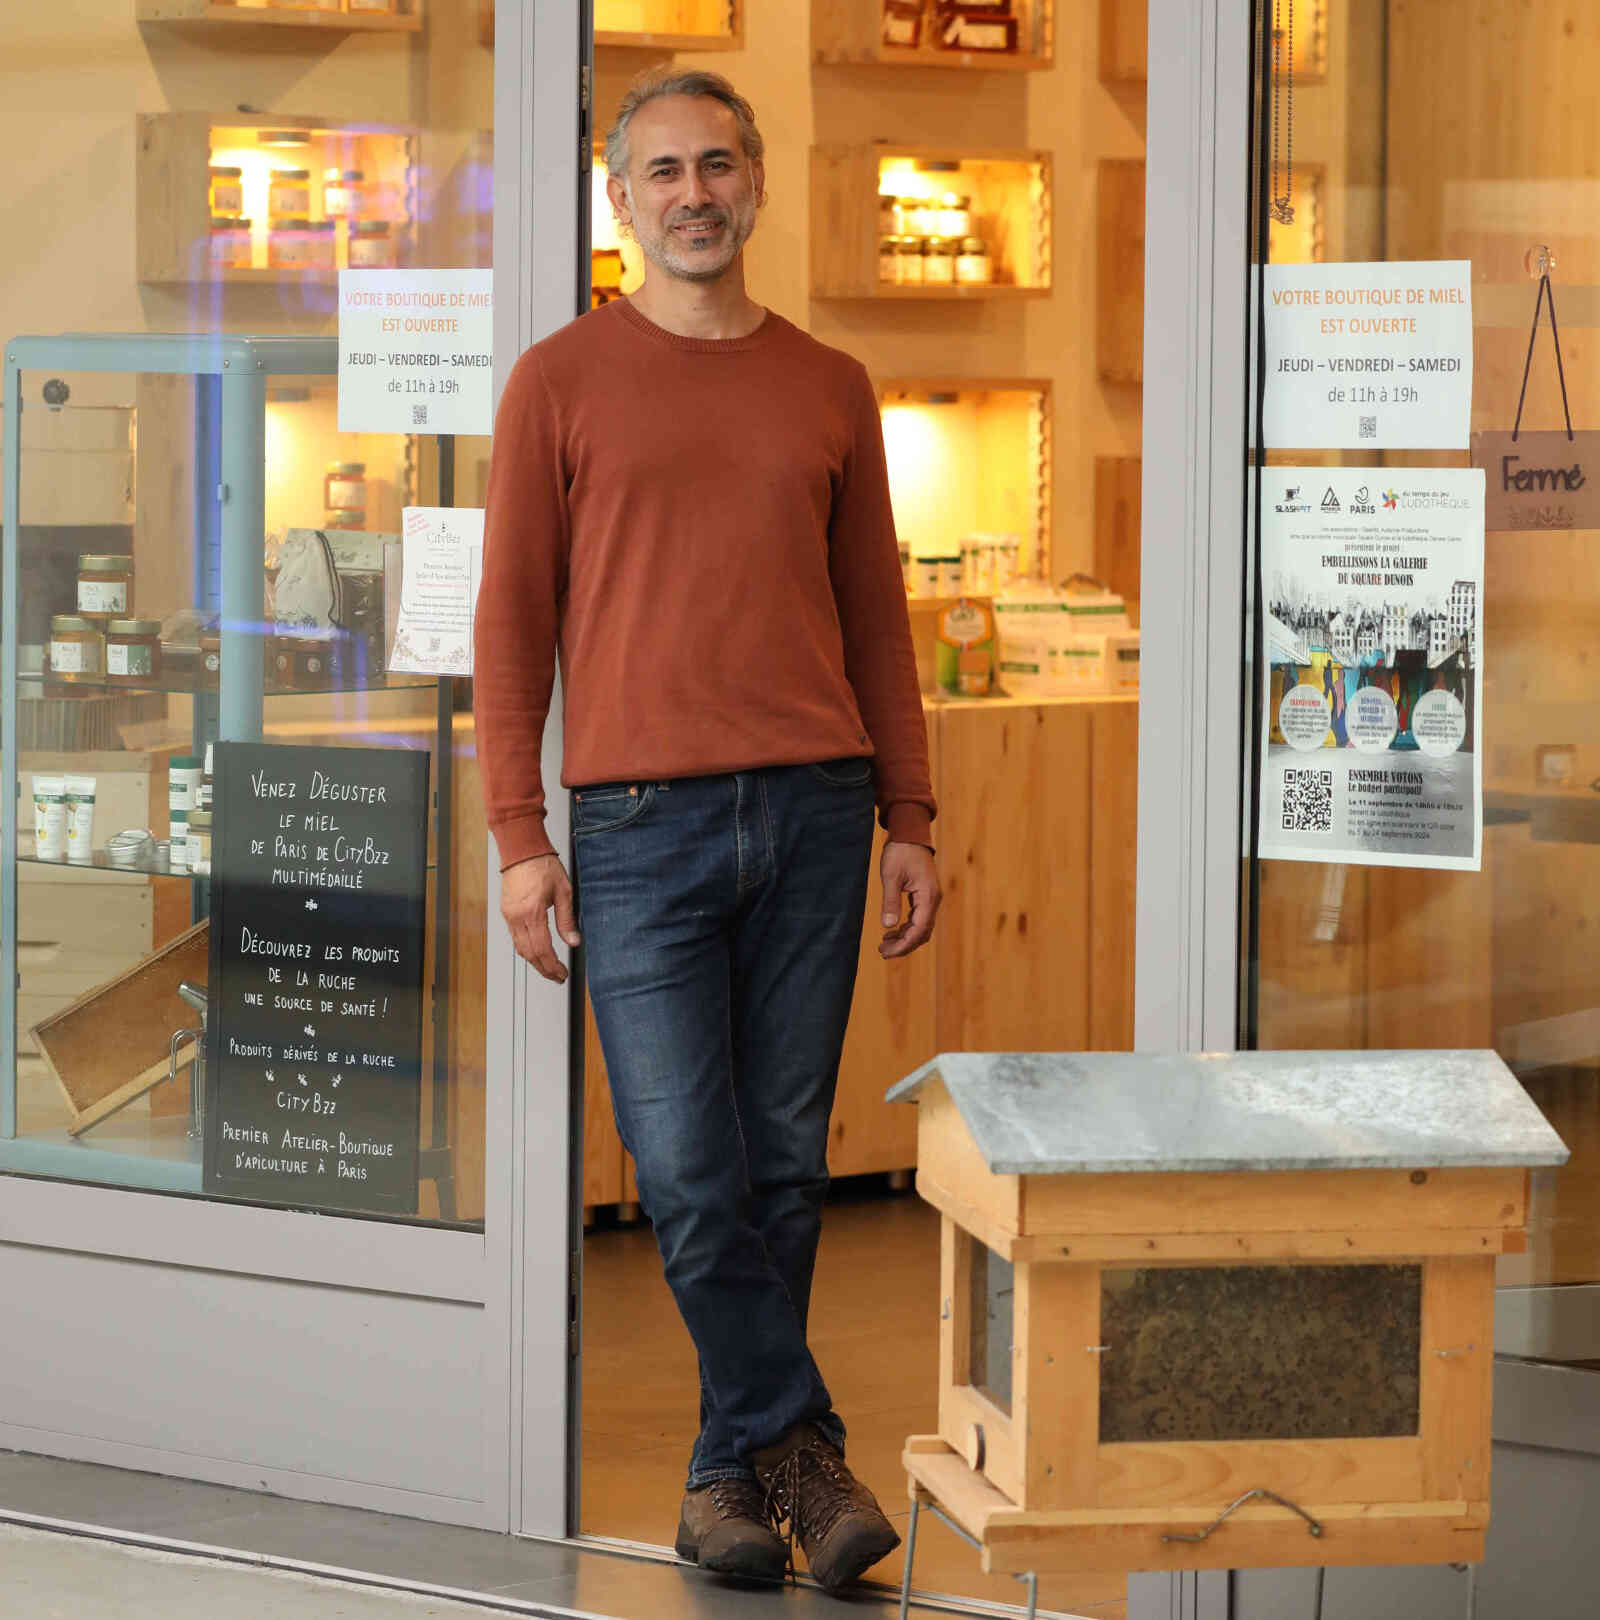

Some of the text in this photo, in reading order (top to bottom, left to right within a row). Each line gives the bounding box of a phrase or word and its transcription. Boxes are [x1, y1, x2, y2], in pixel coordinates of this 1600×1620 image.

[345, 292, 383, 307] VOTRE
[386, 292, 448, 309] BOUTIQUE
[450, 293, 465, 307] DE
[1272, 288, 1465, 306] VOTRE BOUTIQUE DE MIEL
[382, 318, 458, 332] EST OUVERTE
[1320, 318, 1417, 334] EST OUVERTE
[348, 353, 377, 366] JEUDI
[387, 353, 440, 366] VENDREDI
[451, 354, 493, 367] SAMEDI
[1277, 359, 1314, 373] JEUDI
[1328, 358, 1394, 373] VENDREDI
[1408, 358, 1461, 373] SAMEDI
[388, 377, 460, 394] de 11h à 19h
[1328, 386, 1418, 402] de 11h à 19h
[1502, 455, 1587, 492] Fermé
[1350, 504, 1376, 514] PARIS
[1321, 555, 1428, 570] EMBELLISSONS LA GALERIE
[1337, 572, 1414, 586] DU SQUARE DUNOIS
[1348, 769, 1424, 785] ENSEMBLE VOTONS
[279, 811, 340, 832] LE MIEL
[251, 839, 265, 855] DE
[275, 835, 308, 860] PARIS
[316, 846, 329, 861] DE
[272, 867, 363, 889] MULTIMÉDAILLÉ
[240, 926, 400, 963] DÉCOUVREZ LES PRODUITS
[268, 966, 357, 991] DE LA RUCHE
[244, 992, 264, 1006] UNE
[274, 995, 313, 1011] SOURCE
[321, 1000, 334, 1013] DE
[341, 999, 376, 1017] SANTÉ
[229, 1037, 396, 1068] PRODUITS DÉRIVÉS DE LA RUCHE
[223, 1121, 269, 1145] PREMIER
[317, 1158, 326, 1175] À
[337, 1159, 368, 1181] PARIS
